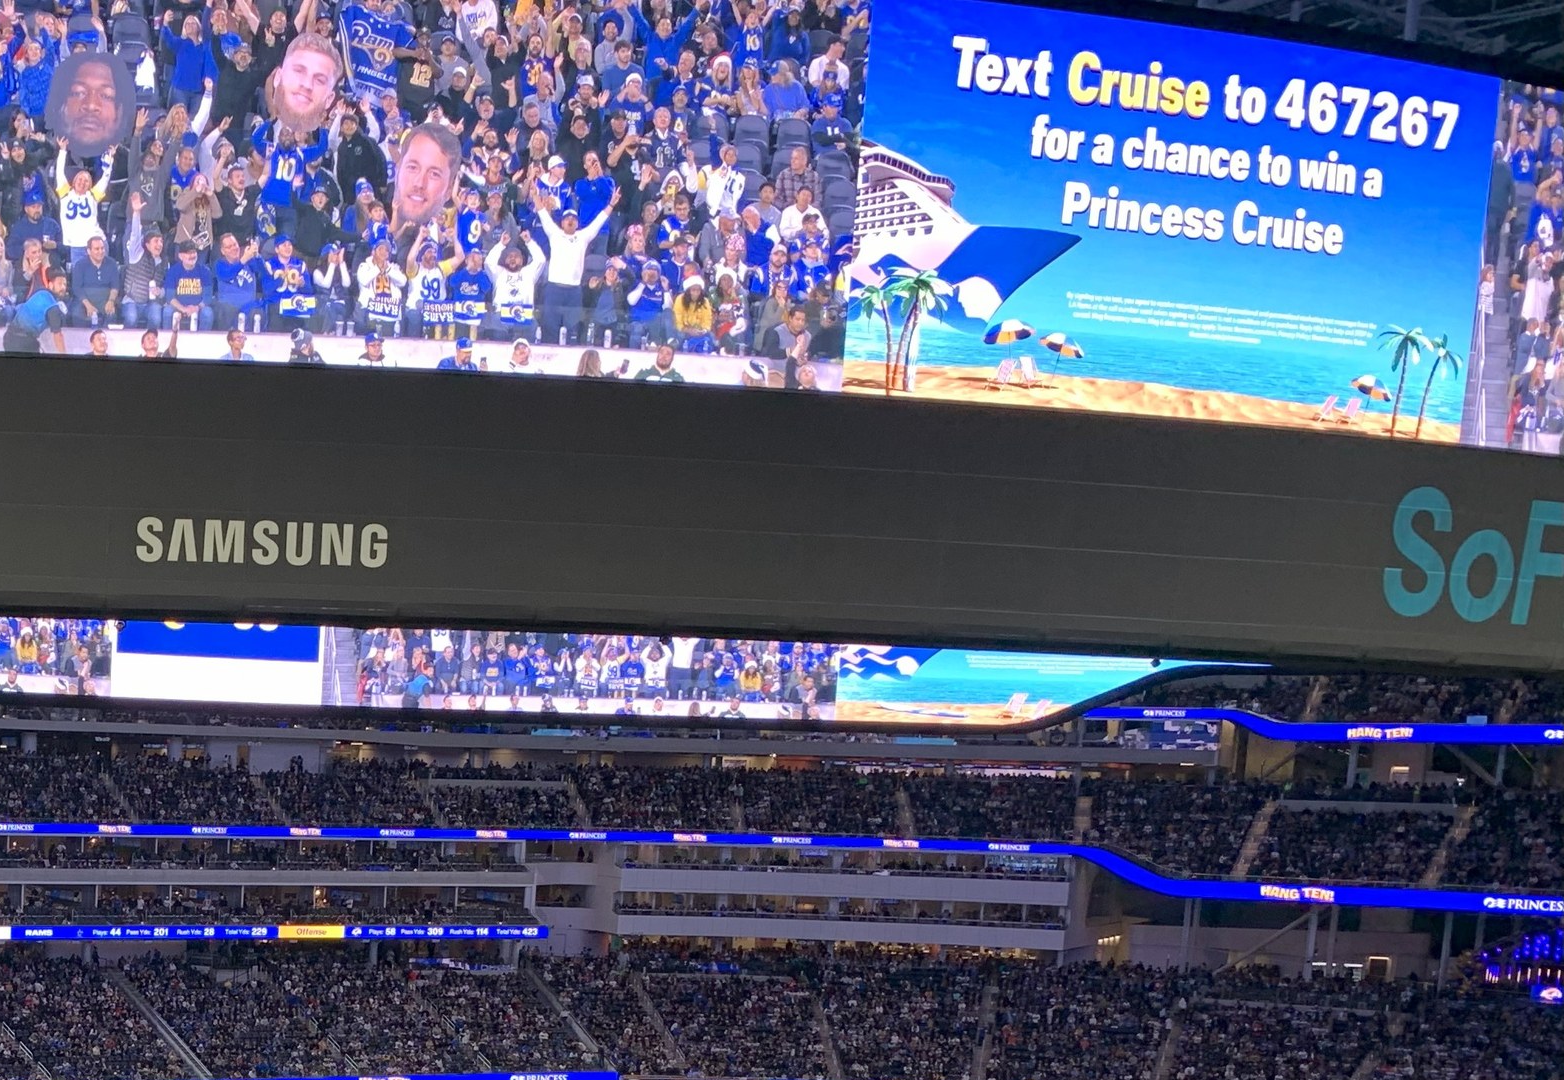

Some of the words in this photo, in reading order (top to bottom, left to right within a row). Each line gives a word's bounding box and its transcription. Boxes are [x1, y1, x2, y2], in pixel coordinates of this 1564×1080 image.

[951, 34, 1052, 99] Text
[1067, 50, 1211, 119] Cruise
[1223, 73, 1266, 126] to
[1274, 78, 1461, 152] 467267
[1030, 113, 1086, 164] for
[1091, 133, 1115, 168] a
[1121, 124, 1251, 183] chance
[1257, 144, 1293, 188] to
[1299, 150, 1358, 196] win
[1362, 167, 1385, 200] a
[65, 200, 93, 221] 99
[1061, 180, 1226, 244] Princess
[1231, 199, 1346, 256] Cruise
[419, 274, 441, 301] 99
[135, 515, 390, 570] SAMSUNG
[1347, 727, 1382, 739] HANG
[1260, 885, 1300, 900] HANG
[25, 929, 53, 937] RAMS
[110, 928, 121, 936] 44
[153, 927, 168, 936] 201
[203, 927, 215, 936] 28
[295, 927, 327, 936] Offense
[427, 927, 443, 936] 309
[522, 927, 538, 935] 423
